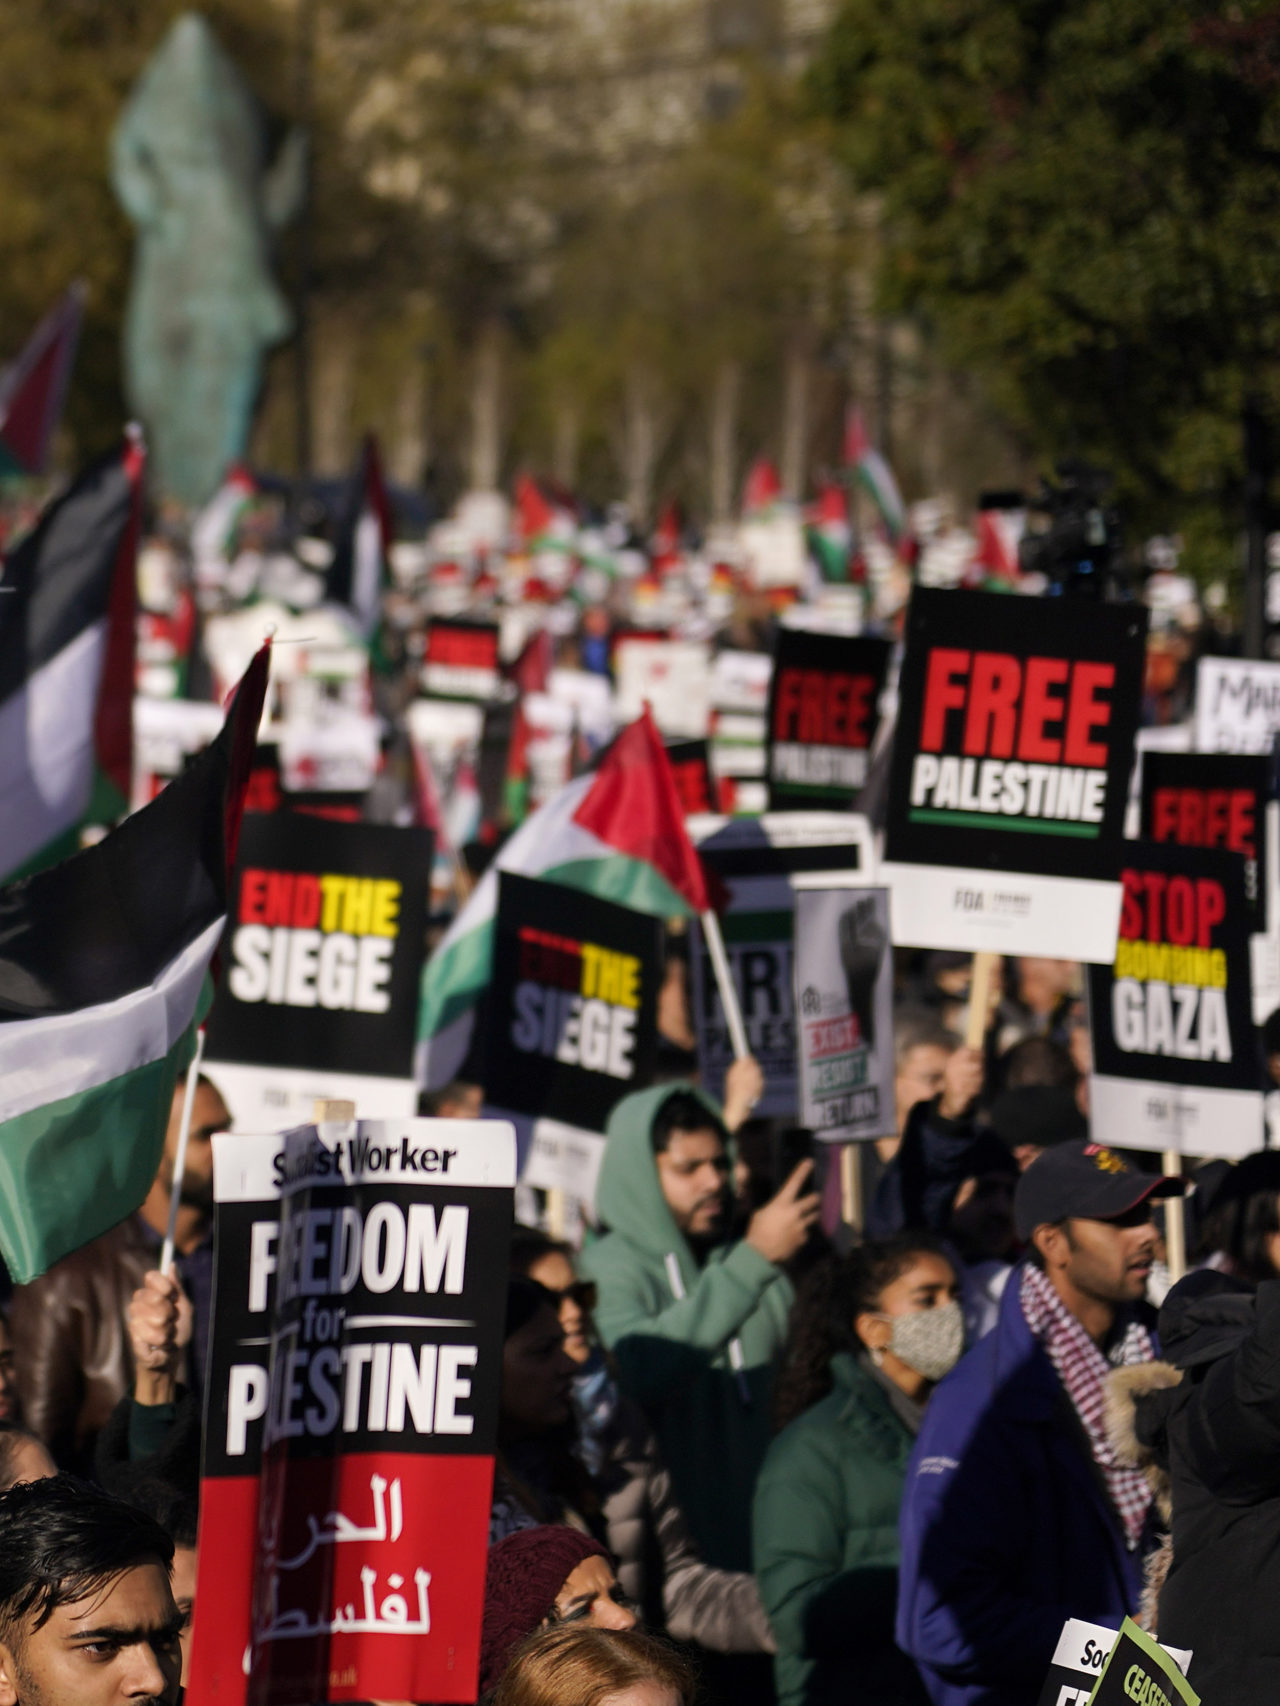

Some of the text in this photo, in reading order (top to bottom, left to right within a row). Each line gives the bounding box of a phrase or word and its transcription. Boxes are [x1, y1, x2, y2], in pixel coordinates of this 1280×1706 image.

[775, 667, 875, 748] FREE
[920, 647, 1116, 767] FREE
[911, 753, 1108, 823] PALESTINE
[1152, 788, 1257, 858] FREE
[238, 868, 402, 938] END THE
[1119, 868, 1226, 950] STOP
[229, 924, 392, 1014] SIEGE
[580, 942, 642, 1009] THE
[512, 980, 639, 1080] SIEGE
[1111, 976, 1232, 1063] GAZA
[302, 1301, 347, 1342] for
